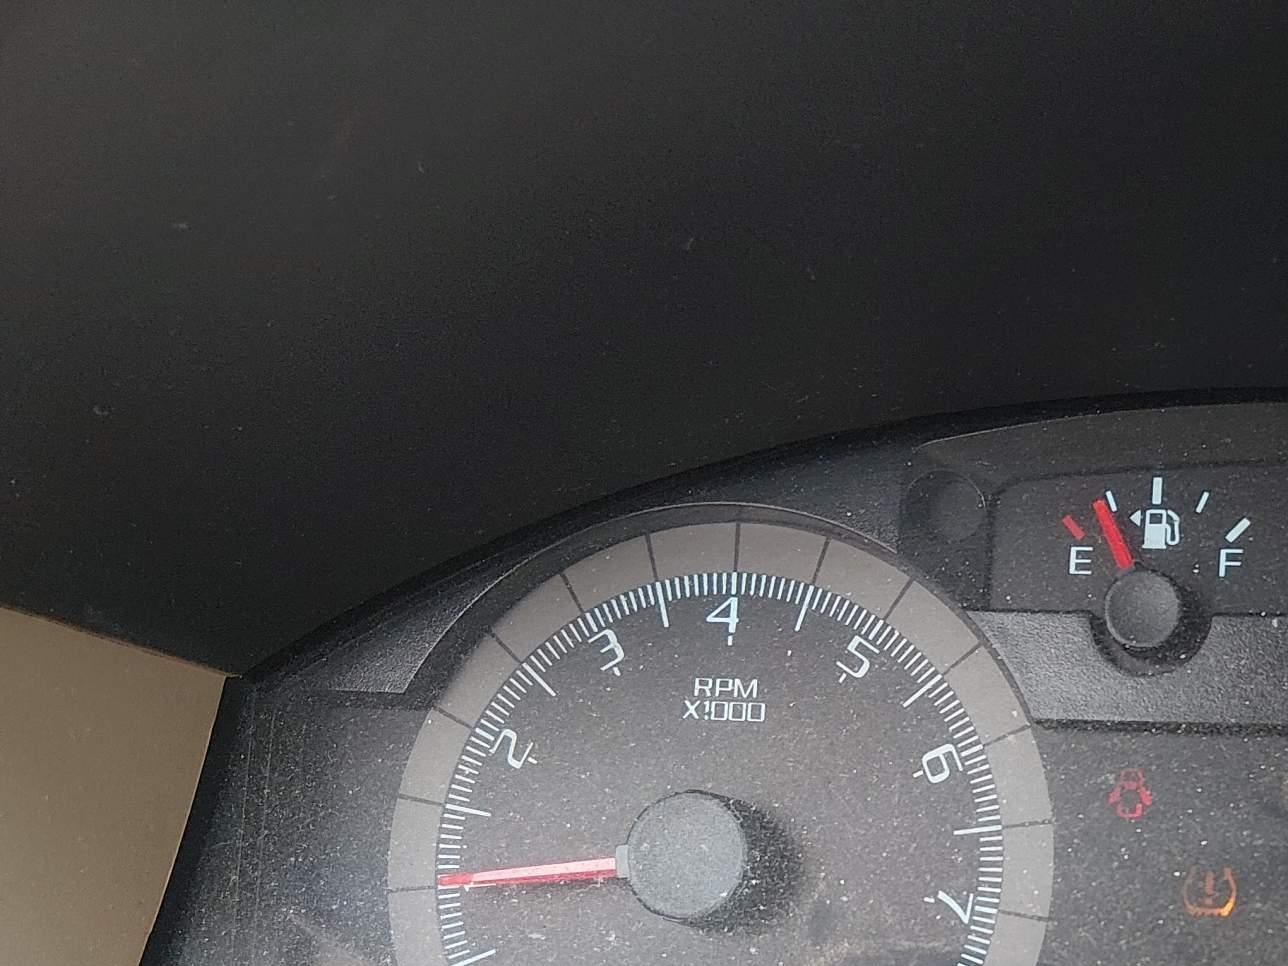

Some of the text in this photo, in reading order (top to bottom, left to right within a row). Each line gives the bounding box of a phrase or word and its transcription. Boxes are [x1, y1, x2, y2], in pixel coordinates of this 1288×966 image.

[1069, 546, 1092, 576] E
[1218, 548, 1244, 577] F
[706, 597, 740, 633] 4
[589, 629, 626, 670] 3
[840, 635, 881, 680] 5
[693, 677, 758, 698] RPM
[490, 728, 533, 768] 2
[920, 743, 964, 783] 6
[938, 890, 973, 924] 7
